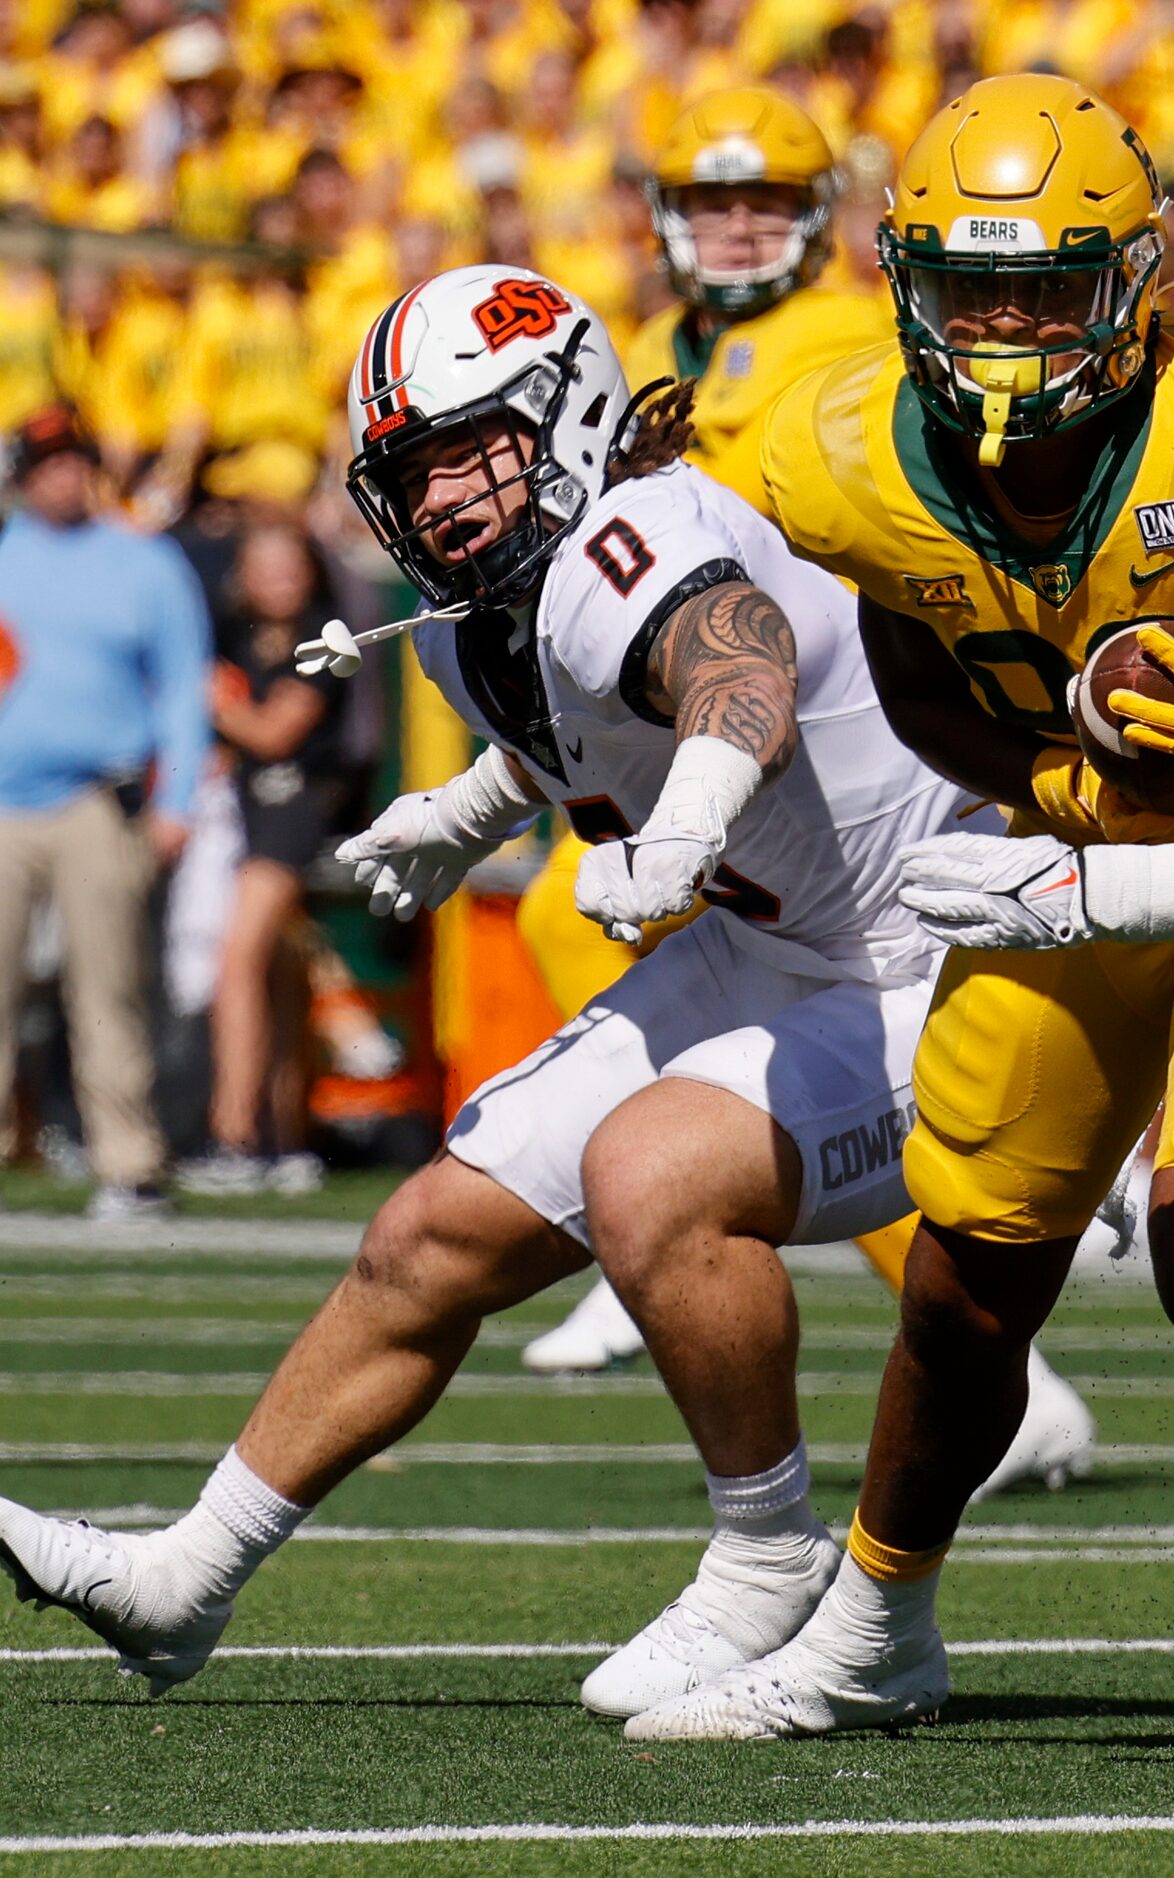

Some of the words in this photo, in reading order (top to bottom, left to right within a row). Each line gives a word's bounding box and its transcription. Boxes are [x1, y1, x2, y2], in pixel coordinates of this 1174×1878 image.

[970, 220, 1018, 240] BEARS
[471, 279, 573, 355] OSU
[367, 410, 406, 442] COWBOYS
[584, 515, 656, 599] 0
